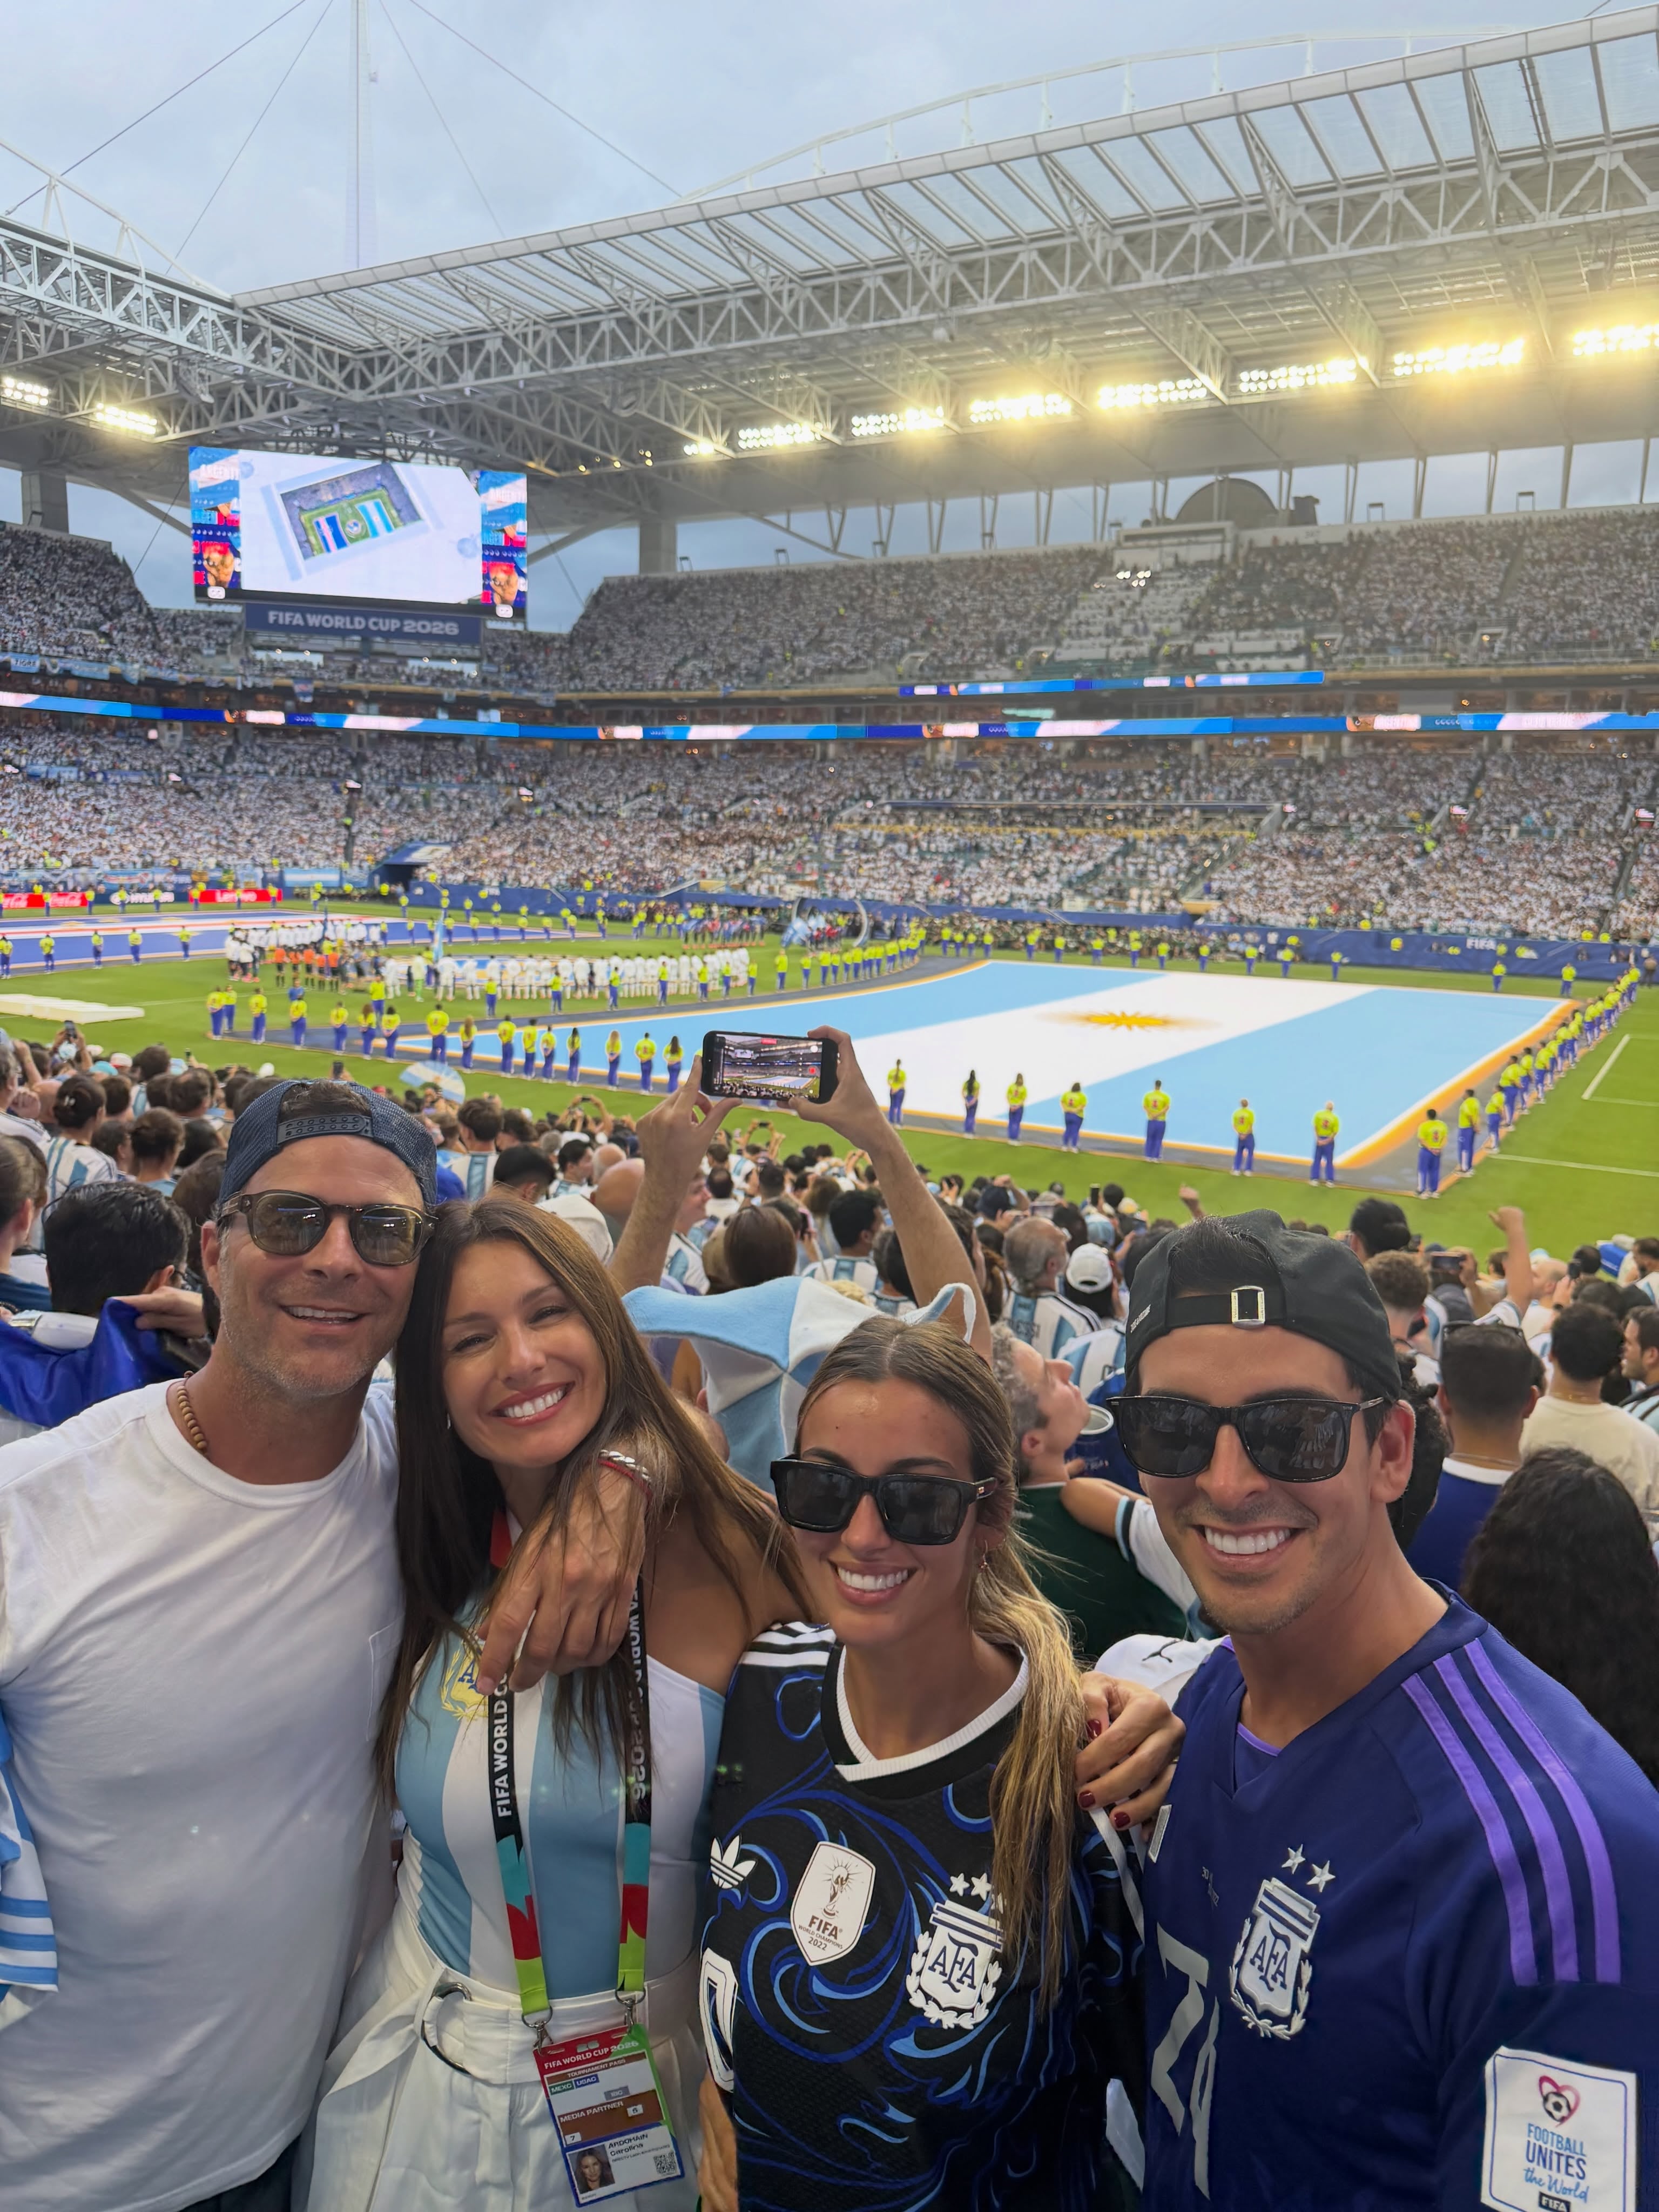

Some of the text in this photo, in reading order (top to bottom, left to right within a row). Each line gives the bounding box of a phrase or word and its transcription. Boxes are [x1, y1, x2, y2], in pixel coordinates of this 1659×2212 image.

[268, 611, 458, 636] FIFA WORLD CUP 2026
[1466, 939, 1495, 950] FIFA
[494, 1700, 508, 1772] WORLD
[495, 1773, 512, 1817] FIFA
[798, 1924, 843, 1950] WORLD CHAMPIONS
[808, 1936, 827, 1951] 2022
[928, 1932, 979, 1993] AFA
[1250, 1920, 1291, 1992] AFA
[544, 2041, 639, 2069] FIFA WORLD CUP 2026
[568, 2059, 626, 2078] TOURNAMENT PASS
[559, 2101, 624, 2123] MEDIA PARTNER
[1527, 2123, 1587, 2157] FOOTBALL
[1526, 2140, 1587, 2180] UNITES
[1523, 2167, 1590, 2204] the World
[1542, 2196, 1567, 2212] FIFA
